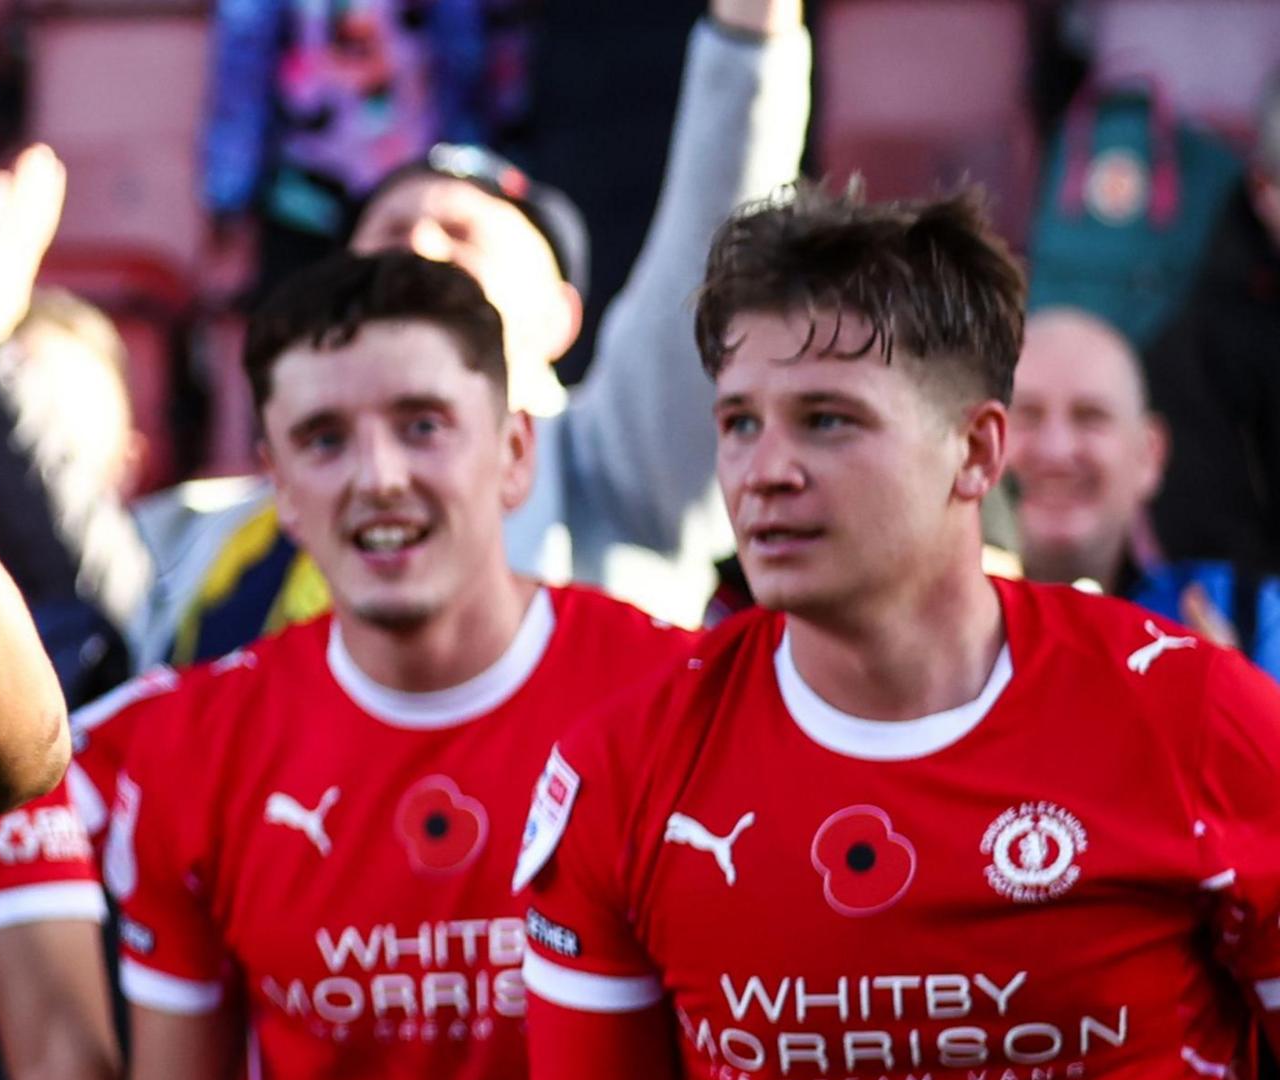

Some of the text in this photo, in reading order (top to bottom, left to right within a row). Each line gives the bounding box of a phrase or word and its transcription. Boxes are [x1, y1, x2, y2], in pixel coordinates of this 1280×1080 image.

[315, 917, 526, 974] WHITB
[261, 969, 526, 1023] MORRIS
[719, 970, 1028, 1024] WHITBY
[676, 1004, 1128, 1076] MORRISON
